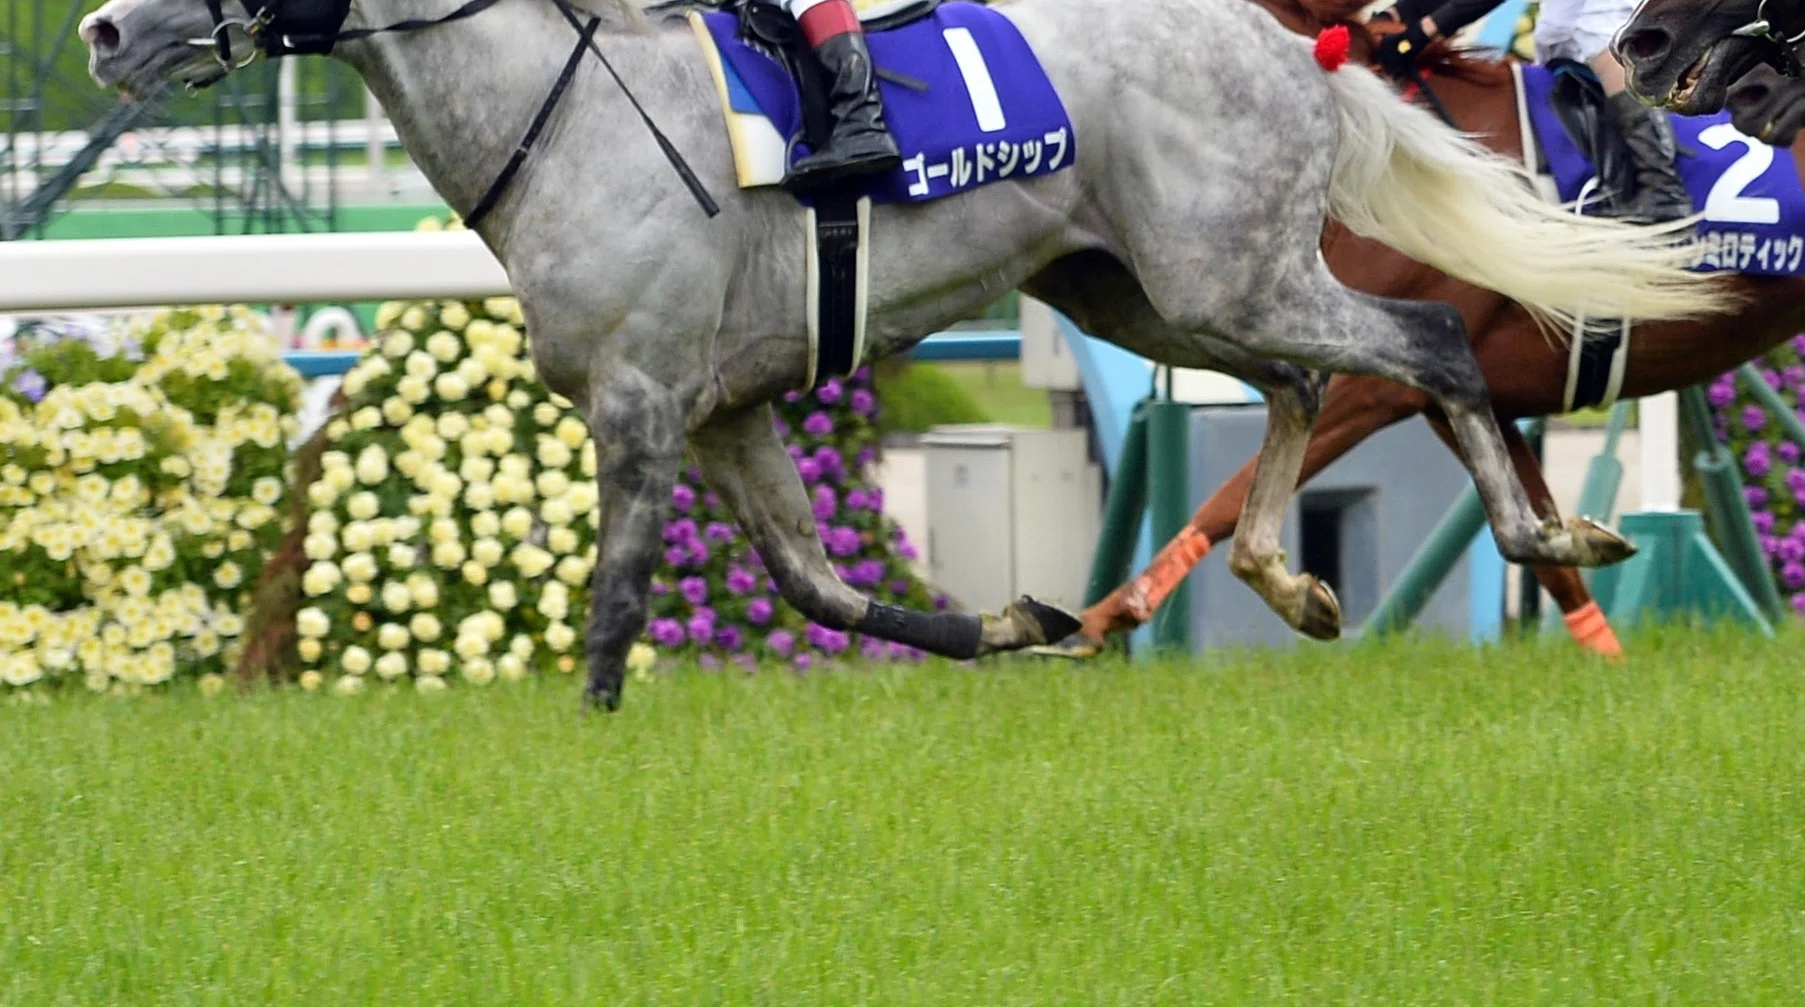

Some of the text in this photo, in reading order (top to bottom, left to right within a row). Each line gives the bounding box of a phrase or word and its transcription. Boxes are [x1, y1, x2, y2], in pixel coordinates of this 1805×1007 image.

[943, 27, 1006, 132] 1
[903, 127, 1067, 197] ゴールドシップ
[1698, 123, 1780, 224] 2
